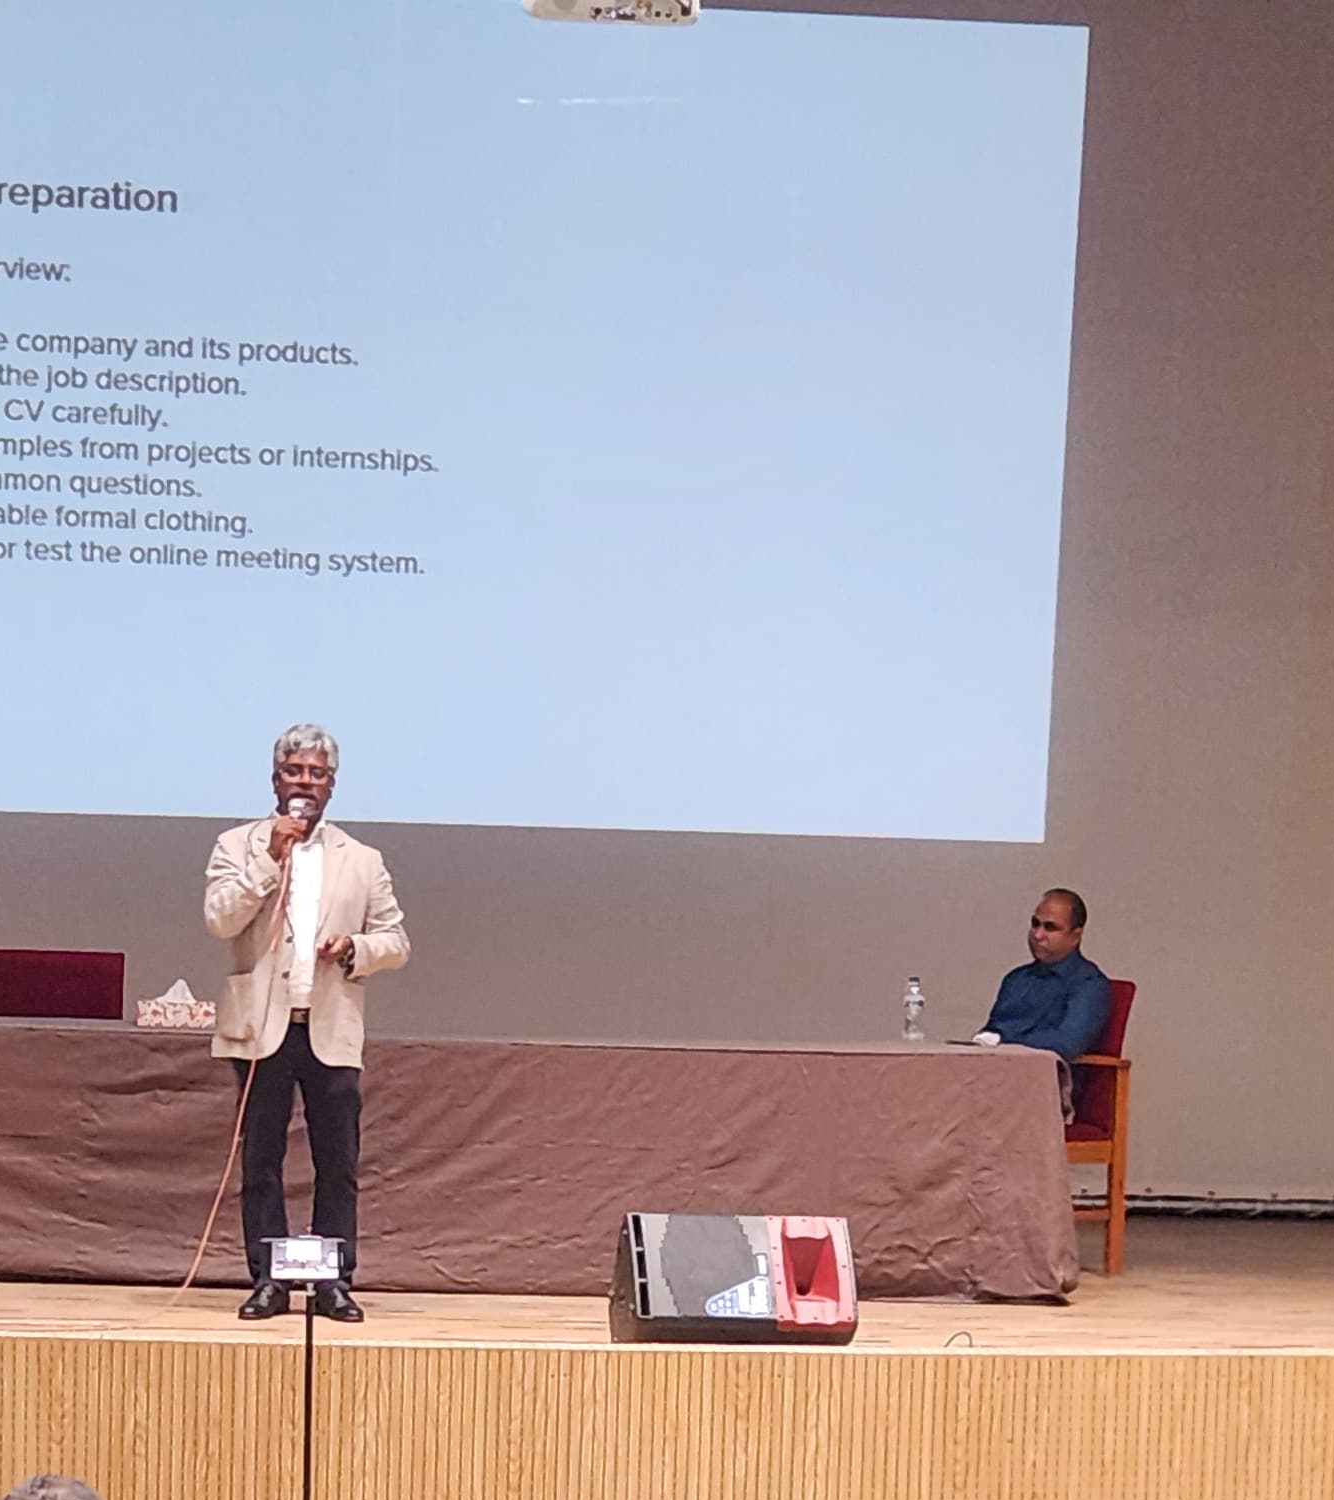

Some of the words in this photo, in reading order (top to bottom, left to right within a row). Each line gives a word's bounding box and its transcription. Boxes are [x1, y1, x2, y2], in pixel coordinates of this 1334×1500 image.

[15, 332, 139, 363] company
[144, 336, 194, 359] and
[200, 336, 232, 361] its
[237, 340, 359, 367] products.
[43, 364, 89, 394] job
[94, 367, 247, 399] description.
[3, 398, 46, 423] CV
[50, 402, 169, 433] carefully.
[79, 436, 140, 462] from
[146, 440, 252, 470] projects
[258, 447, 286, 467] or
[292, 444, 439, 477] internships.
[68, 472, 203, 500] questions.
[54, 504, 137, 530] formal
[143, 508, 254, 540] clothing.
[23, 538, 74, 563] test
[79, 539, 123, 564] the
[128, 543, 209, 567] online
[215, 547, 321, 577] meeting
[327, 551, 425, 578] system.
